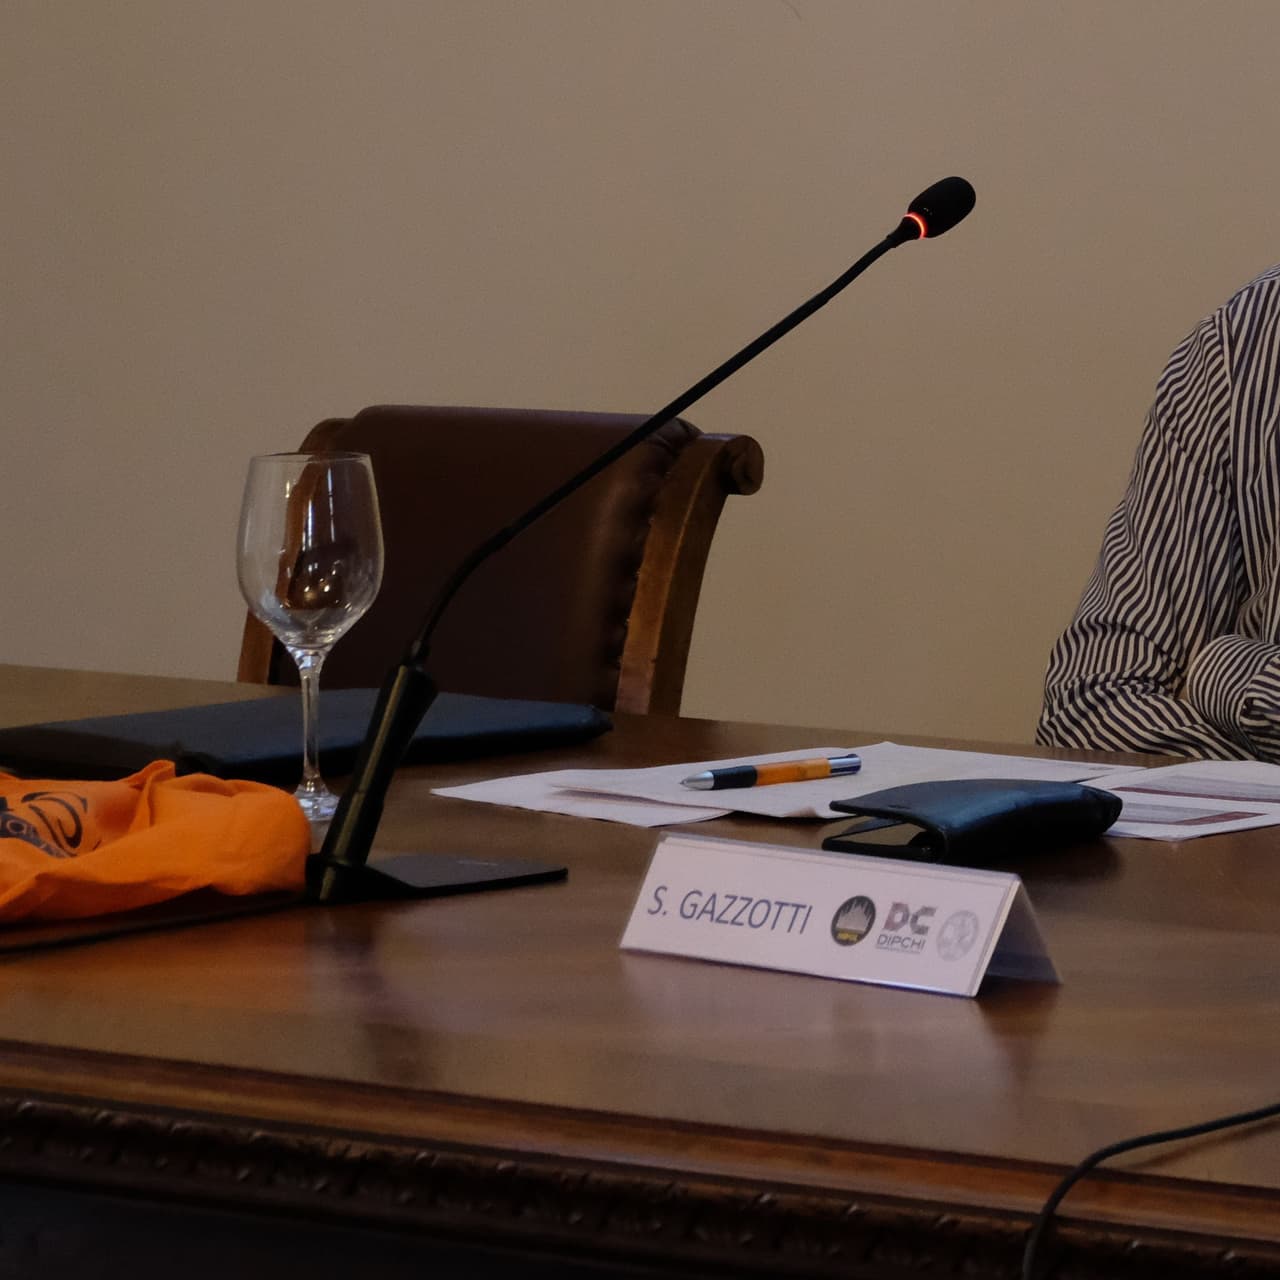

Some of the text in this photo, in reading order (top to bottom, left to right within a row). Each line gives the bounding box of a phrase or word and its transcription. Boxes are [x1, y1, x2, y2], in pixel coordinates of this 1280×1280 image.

[648, 885, 813, 934] S. GAZZOTTI
[883, 901, 937, 935] DC
[877, 934, 926, 951] DIPCHI
